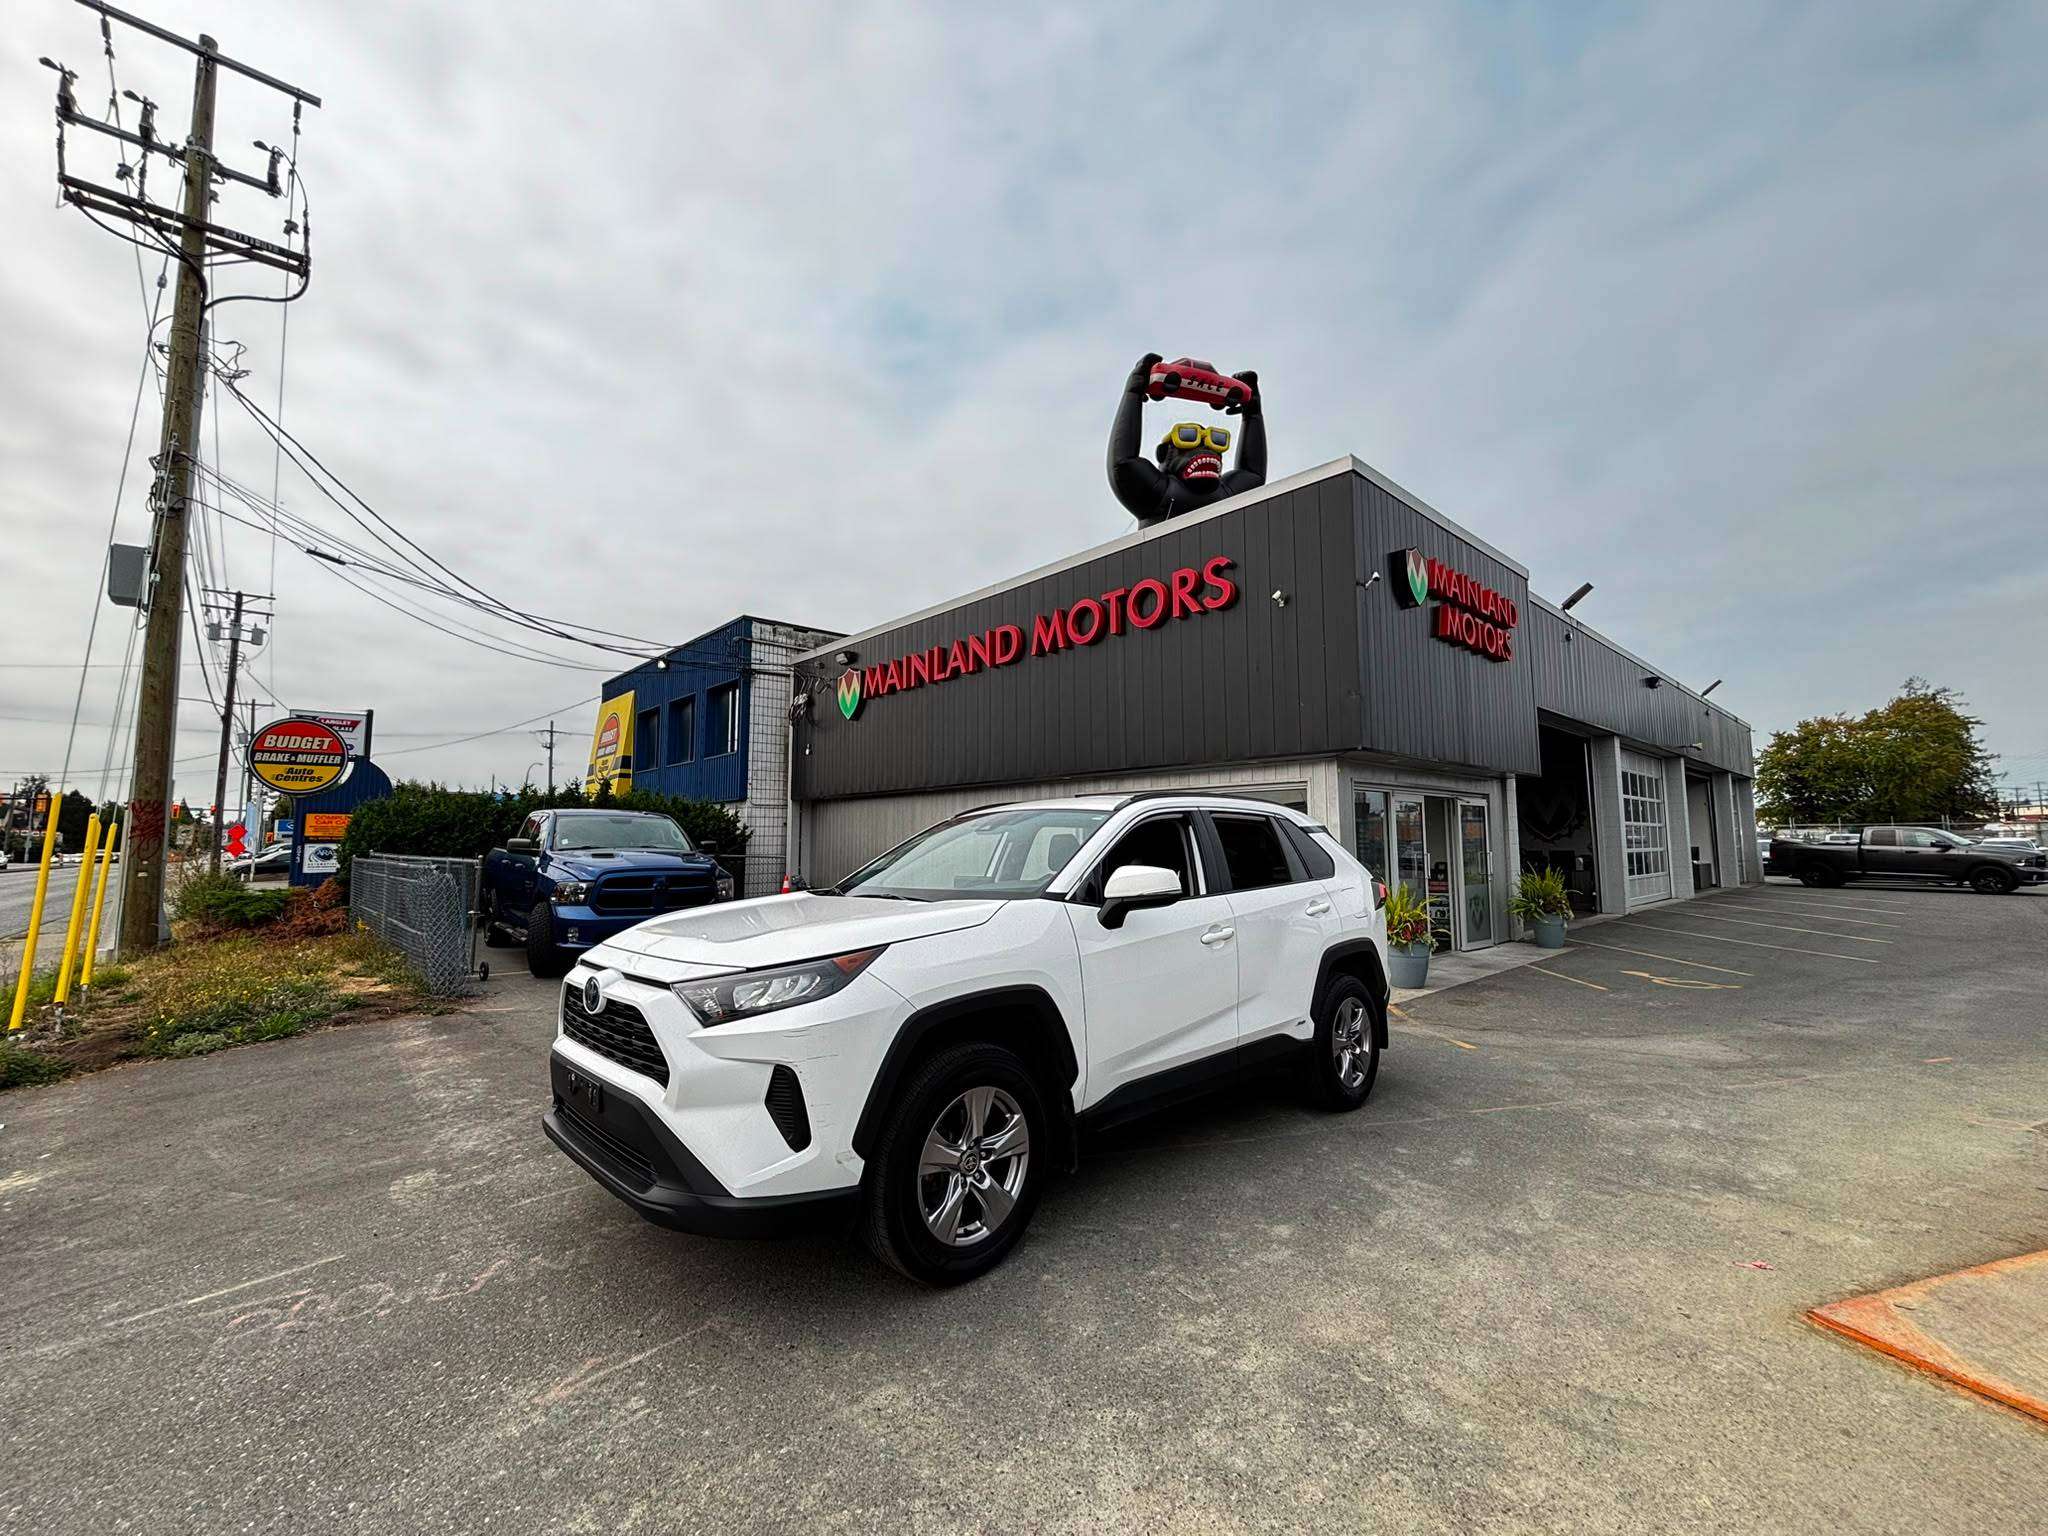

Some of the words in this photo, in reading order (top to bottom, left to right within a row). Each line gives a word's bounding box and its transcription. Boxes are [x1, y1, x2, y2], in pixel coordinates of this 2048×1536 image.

[1427, 557, 1519, 628] MAINLAND
[862, 624, 1025, 700] MAINLAND
[1031, 555, 1237, 657] MOTORS
[1439, 603, 1513, 661] MOTORS
[264, 734, 333, 750] BUDGET
[254, 752, 290, 762] BRAKE
[297, 753, 342, 764] MUFFLER
[275, 773, 323, 783] Centres
[285, 767, 314, 775] Auto
